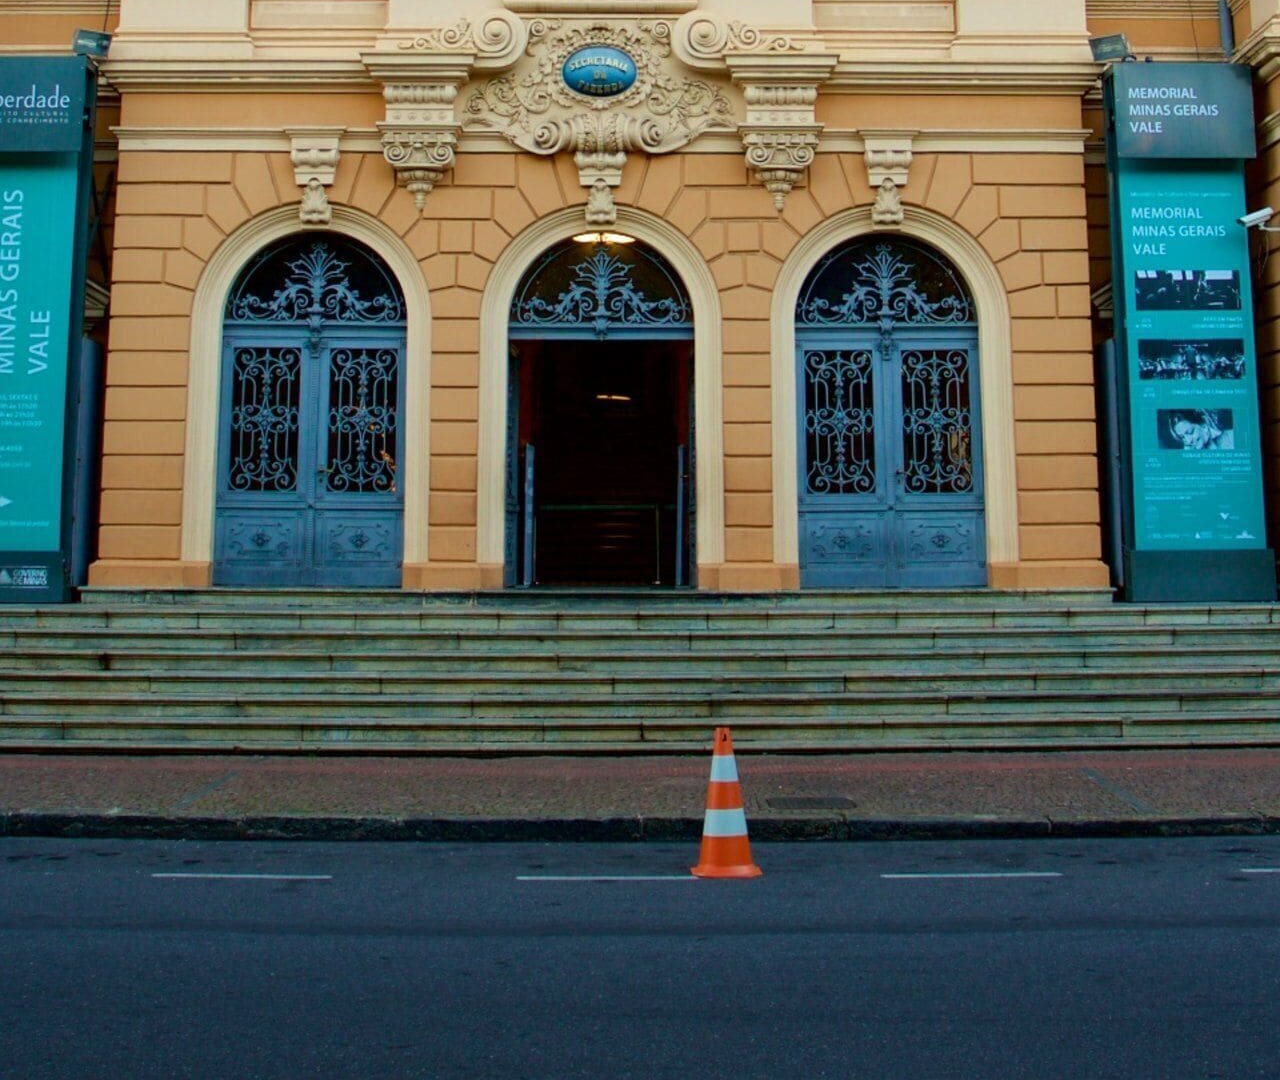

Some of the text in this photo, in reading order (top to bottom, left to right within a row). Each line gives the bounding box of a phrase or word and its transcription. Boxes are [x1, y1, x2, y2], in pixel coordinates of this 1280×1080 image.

[568, 56, 629, 72] SECRETARIA
[1127, 87, 1199, 99] MEMORIAL
[1129, 104, 1220, 117] MINAS GERAIS
[1129, 121, 1163, 134] VALE
[1131, 207, 1205, 219] MEMORIAL
[0, 189, 24, 282] GERAIS
[1132, 225, 1227, 237] MINAS GERAIS
[1132, 243, 1167, 255] VALE
[27, 310, 51, 375] VALE
